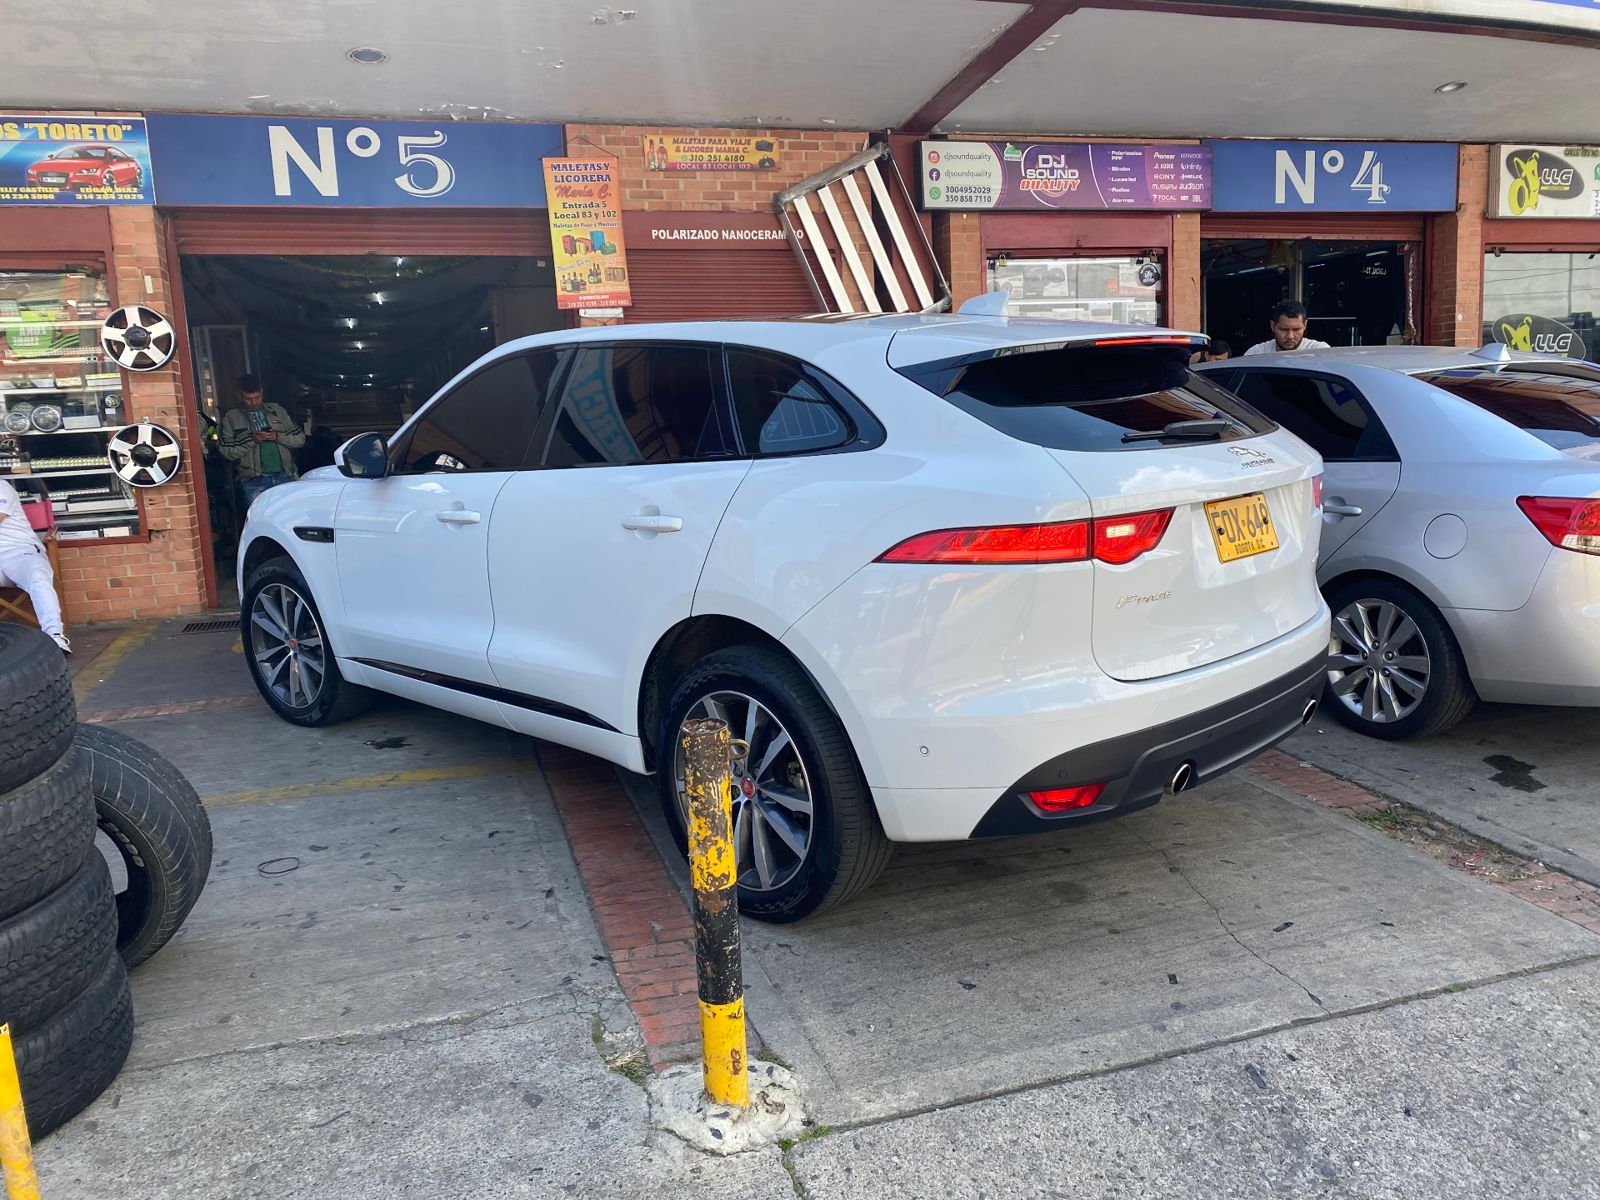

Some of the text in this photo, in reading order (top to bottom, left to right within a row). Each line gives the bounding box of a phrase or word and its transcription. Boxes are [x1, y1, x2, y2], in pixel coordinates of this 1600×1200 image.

[0, 122, 20, 139] S
[672, 137, 751, 146] MALETAS PARA VIAJE
[689, 154, 704, 162] 310
[707, 154, 721, 162] 251
[944, 153, 992, 161] djsoundquality
[1038, 155, 1065, 168] DJ
[394, 130, 455, 198] 5
[550, 163, 610, 172] MALETAS Y
[944, 170, 992, 178] djsoundquality
[1026, 169, 1079, 178] SOUND
[1350, 150, 1391, 204] 4
[1541, 168, 1574, 185] LLG
[553, 175, 612, 183] LICORERA
[1020, 179, 1080, 190] QUALITY
[1179, 182, 1204, 190] audison
[597, 184, 612, 199] C.
[553, 211, 579, 219] Local
[652, 230, 718, 239] POLARIZADO
[1535, 333, 1572, 352] LLG
